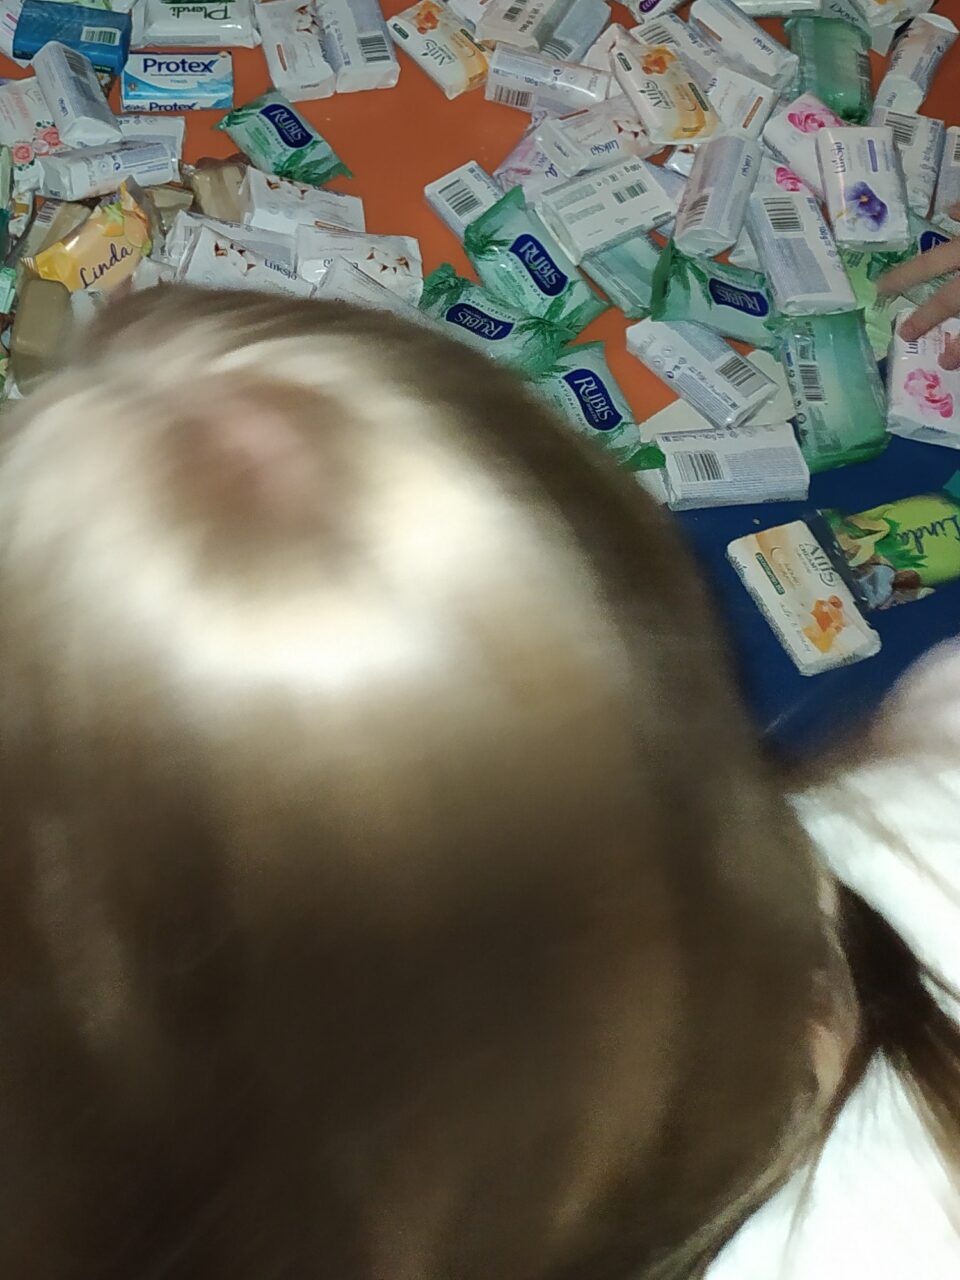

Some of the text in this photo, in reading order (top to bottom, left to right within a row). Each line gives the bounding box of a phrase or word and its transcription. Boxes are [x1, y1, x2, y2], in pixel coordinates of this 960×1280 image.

[169, 6, 231, 21] Plendi
[143, 58, 218, 74] Protex
[149, 102, 199, 112] Protex
[269, 108, 306, 141] RUBIS
[590, 139, 620, 155] Luksja
[834, 141, 846, 175] Luksja
[80, 242, 133, 289] Linda
[264, 259, 297, 280] Luksja
[520, 241, 560, 286] RUBIS
[716, 287, 760, 312] RUBIS
[455, 310, 503, 339] RUBIS
[575, 376, 613, 423] RUBIS
[804, 542, 838, 587] Attis
